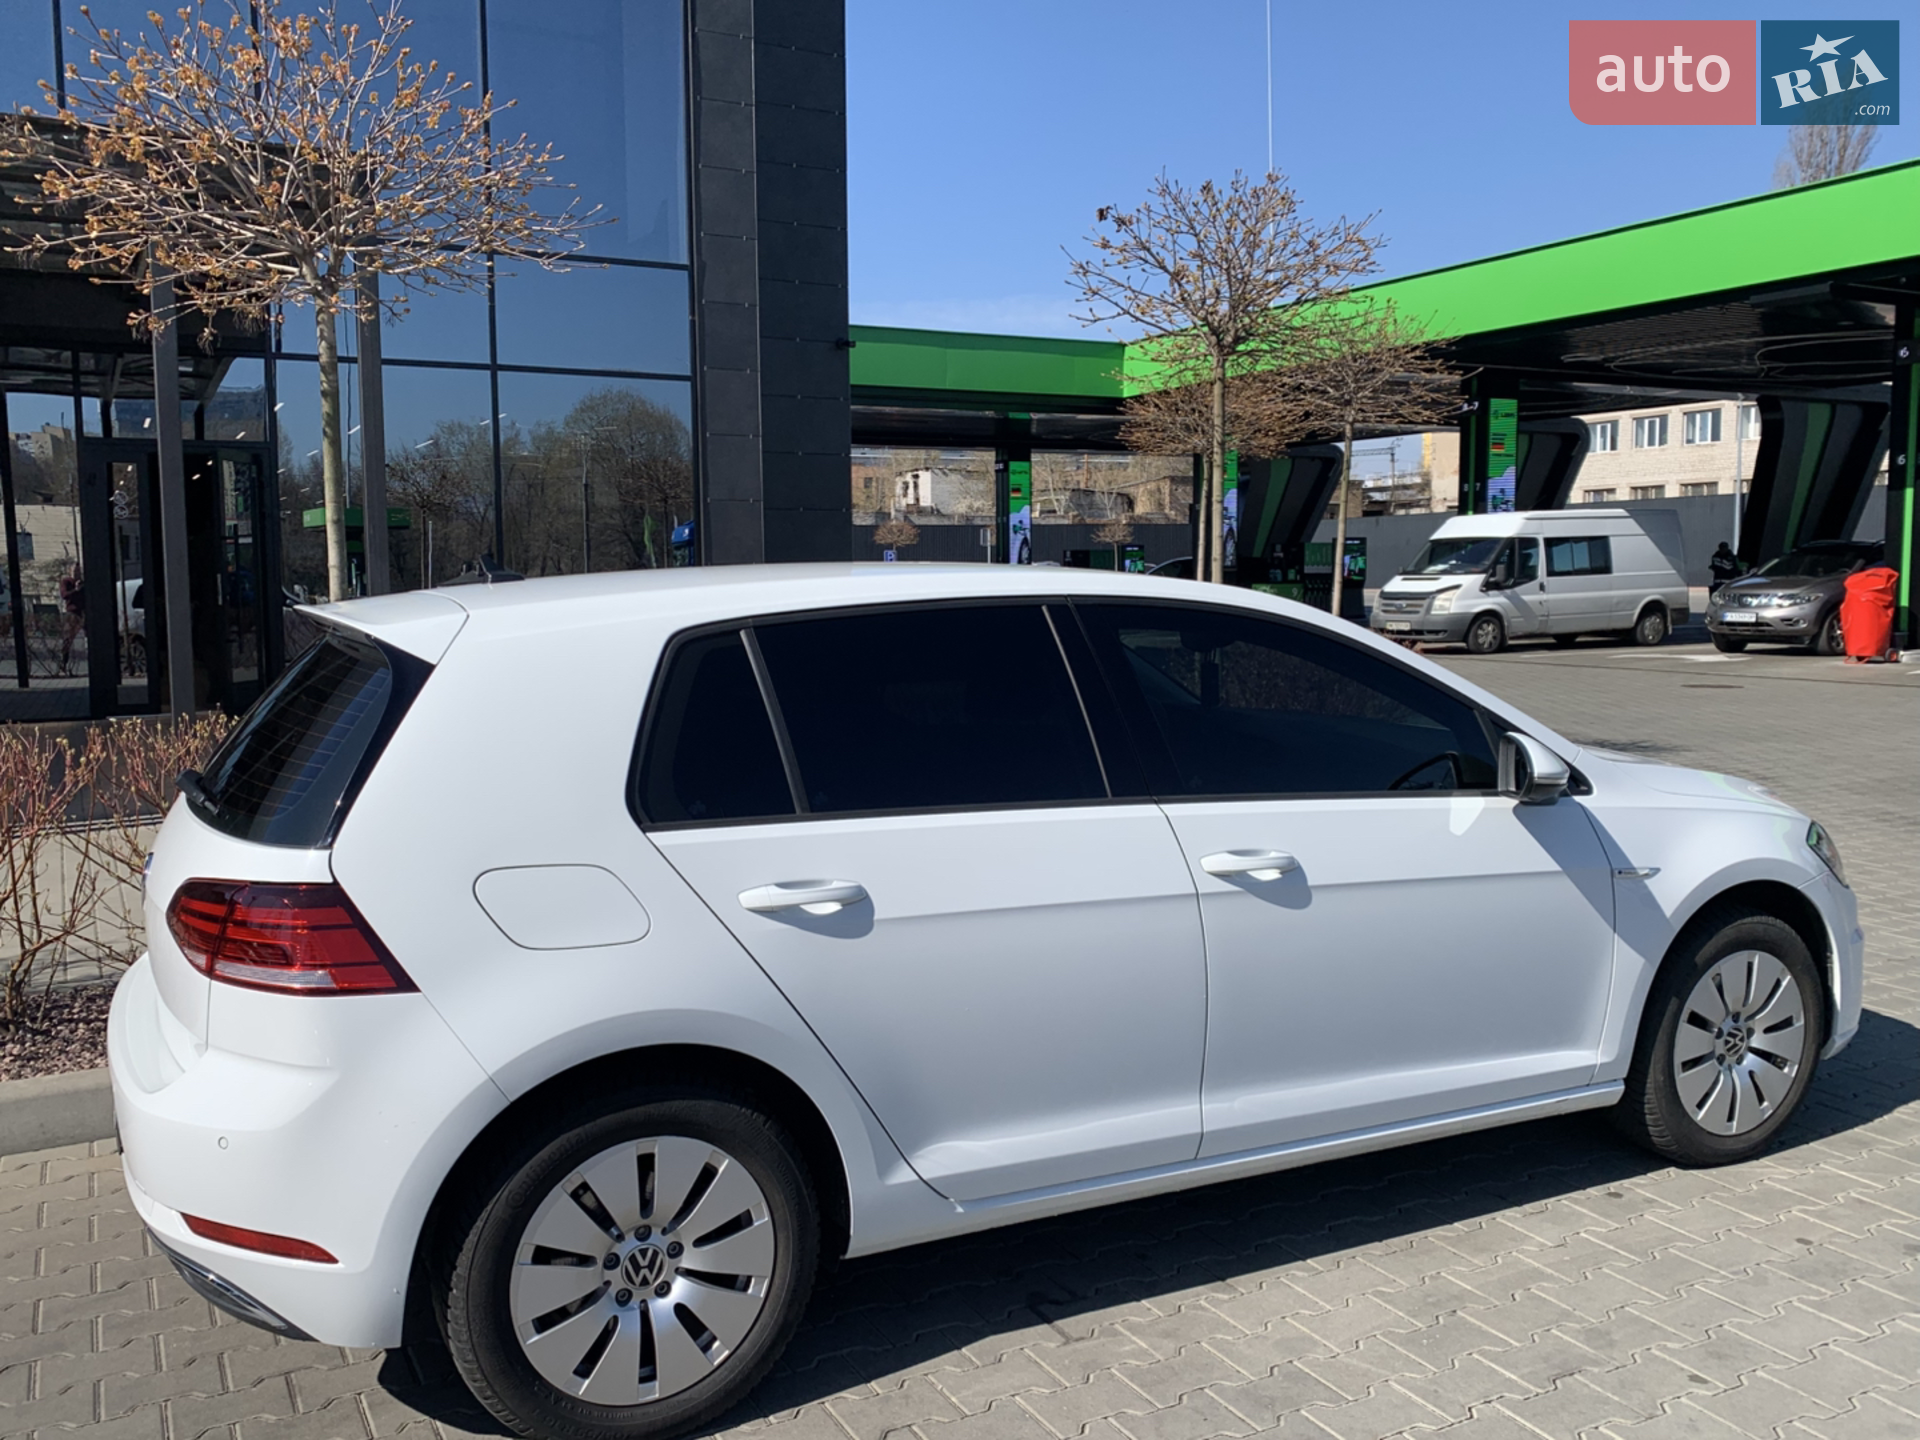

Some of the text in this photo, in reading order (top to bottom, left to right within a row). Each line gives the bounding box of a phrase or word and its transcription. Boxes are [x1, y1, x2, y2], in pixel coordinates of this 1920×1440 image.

[1898, 347, 1909, 358] 6
[1897, 454, 1906, 465] 6
[505, 1126, 594, 1210] Continental
[624, 1246, 665, 1288] VW
